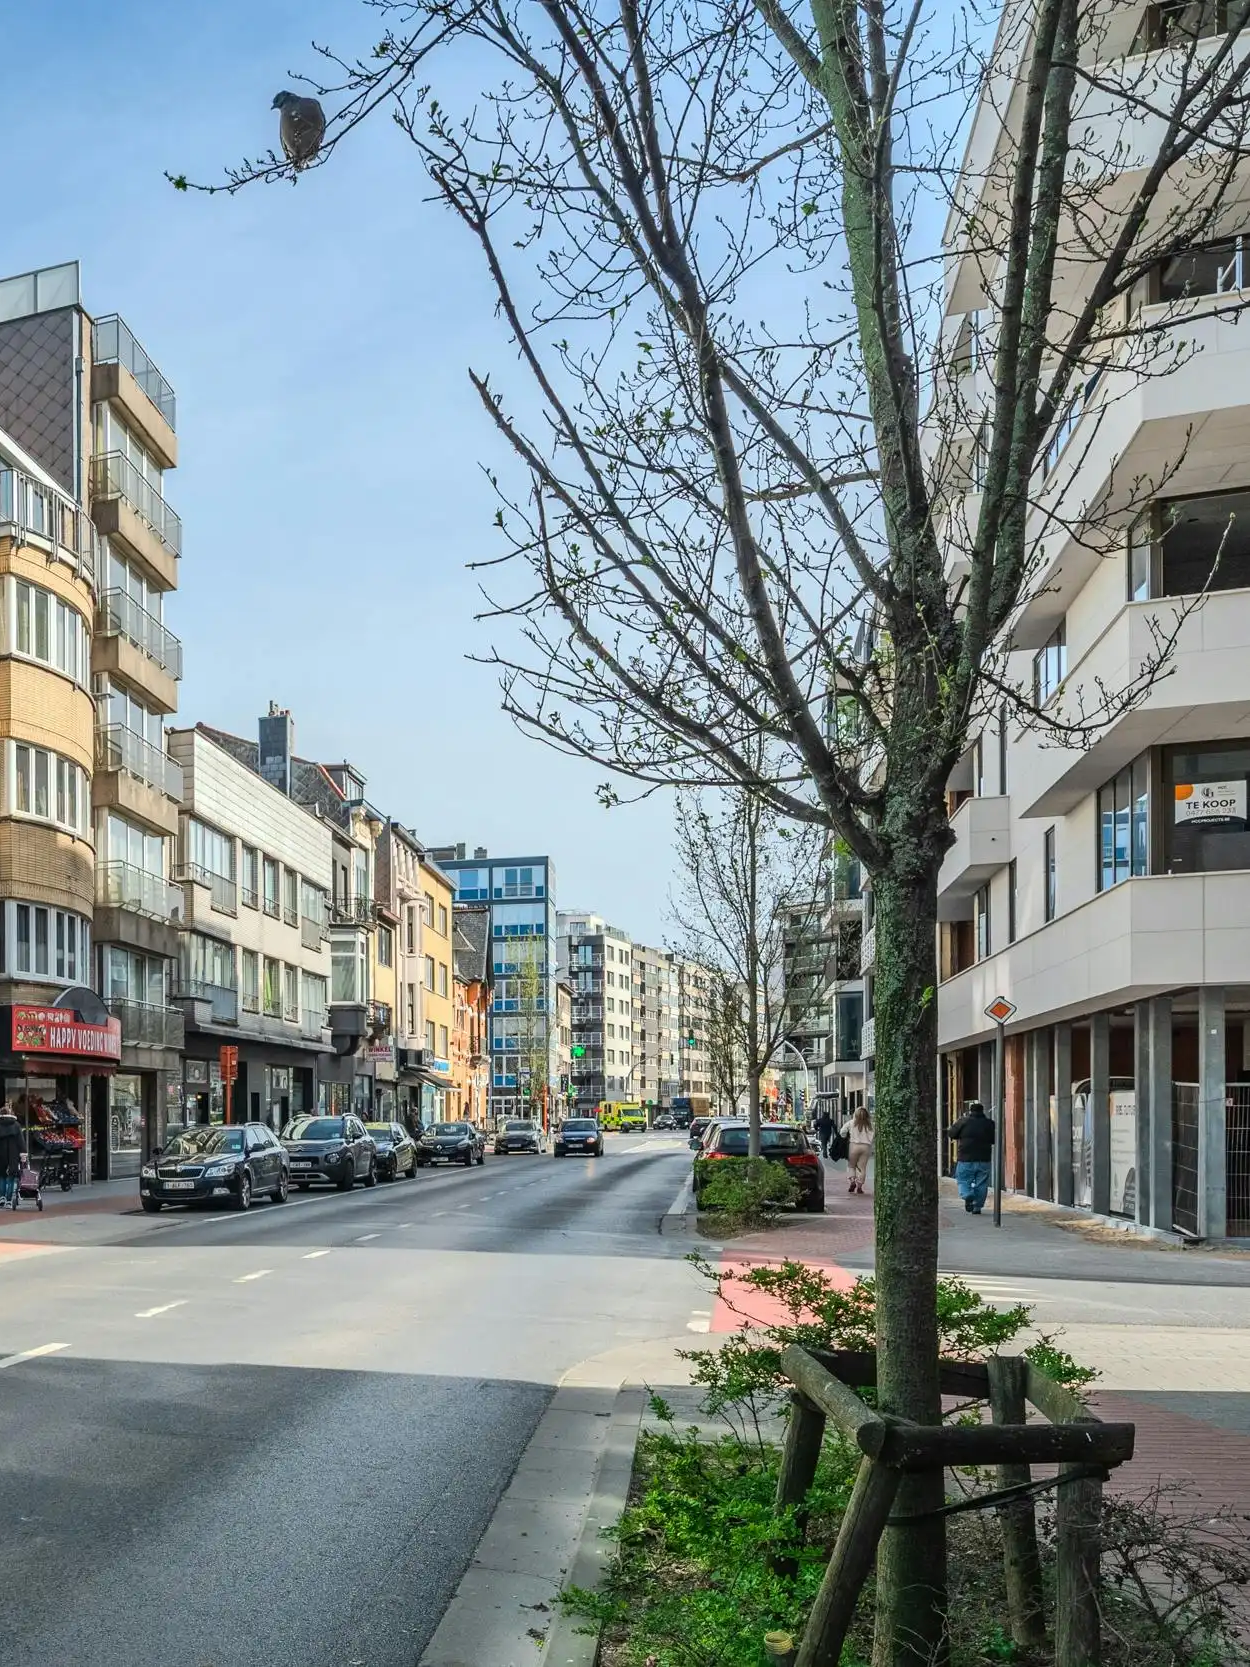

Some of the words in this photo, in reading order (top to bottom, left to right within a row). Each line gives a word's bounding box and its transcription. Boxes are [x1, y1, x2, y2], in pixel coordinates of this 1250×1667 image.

[1203, 799, 1236, 808] KOOP
[50, 1026, 76, 1049] HAPPY
[78, 1029, 103, 1052] VOEDING
